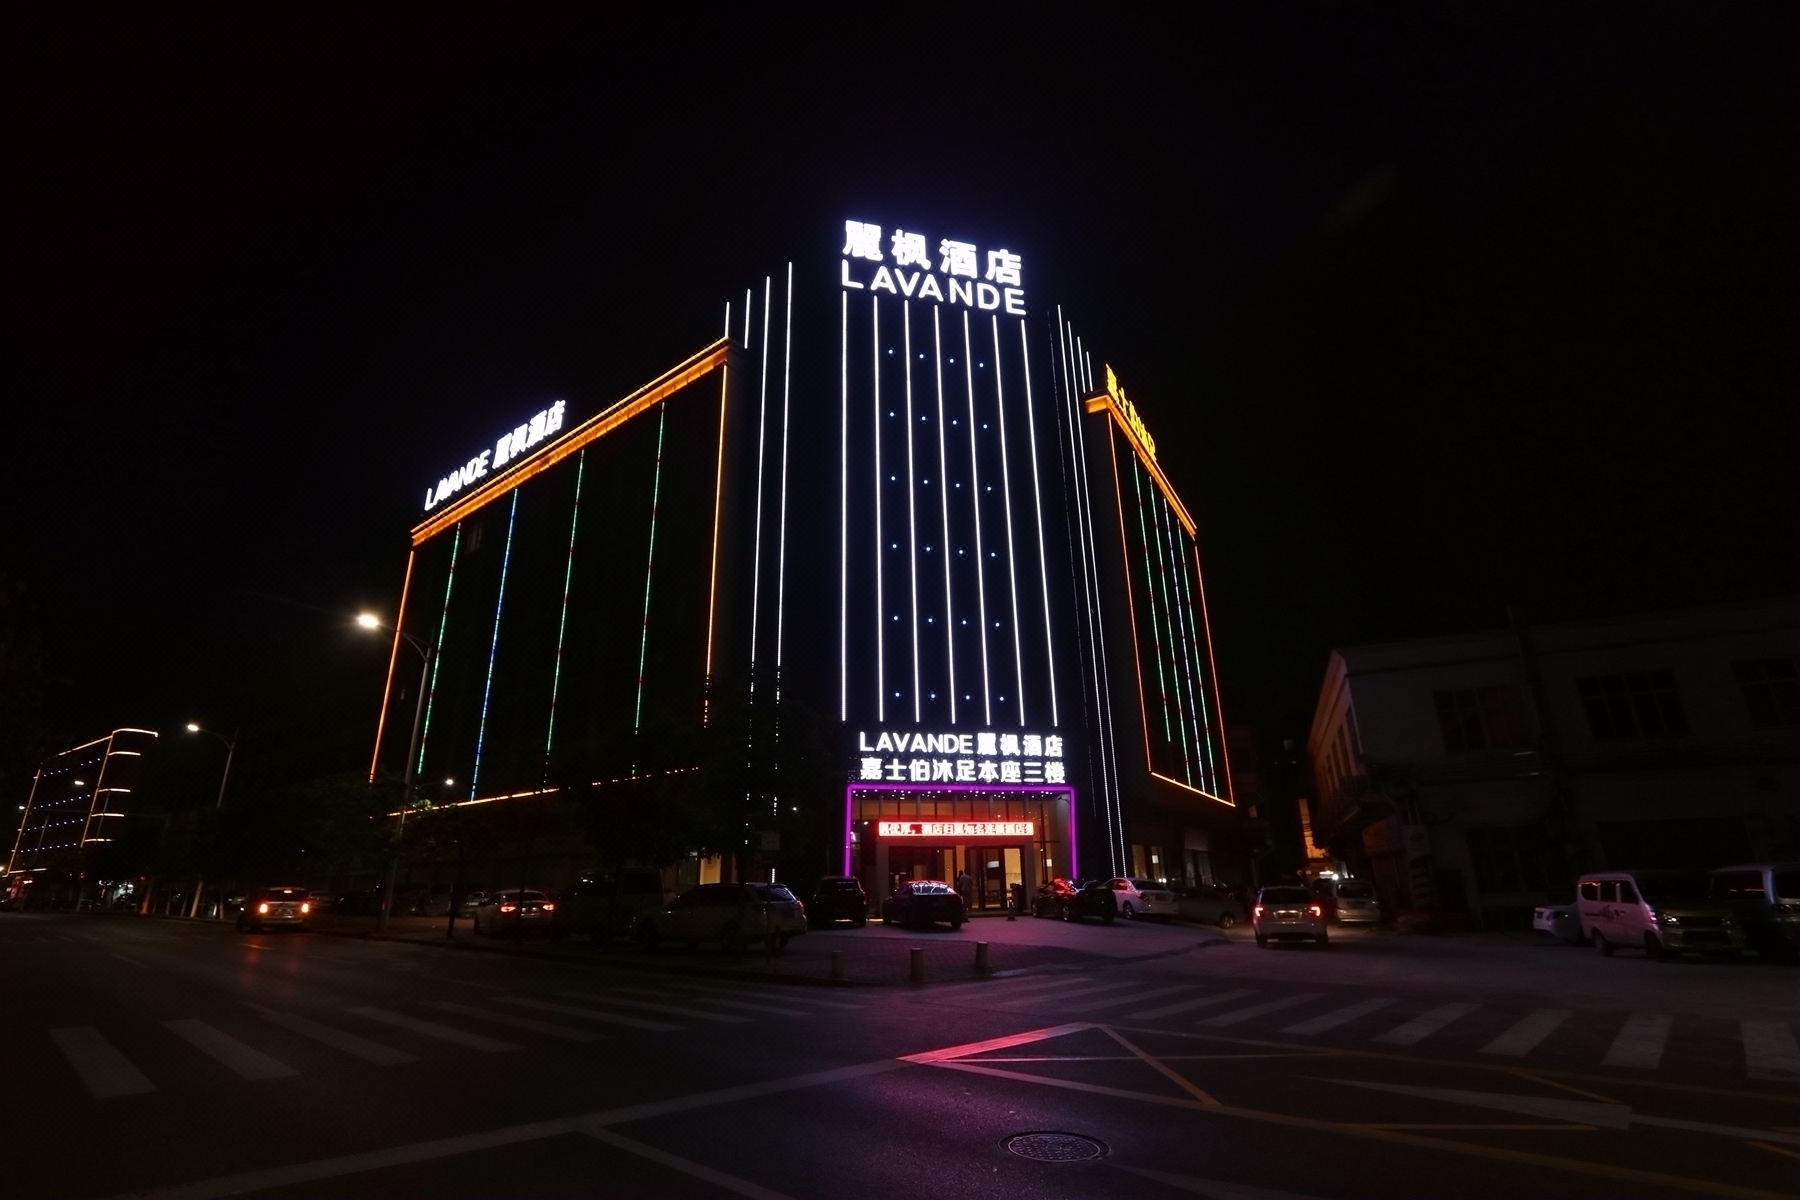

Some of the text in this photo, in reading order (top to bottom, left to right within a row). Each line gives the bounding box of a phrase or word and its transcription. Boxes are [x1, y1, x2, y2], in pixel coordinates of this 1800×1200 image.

[843, 220, 1021, 286] 麗枫酒店
[842, 259, 1026, 315] LAVANDE
[425, 449, 491, 511] LAVANDE
[860, 732, 973, 754] LAVANDE
[860, 757, 1065, 783] 嘉士伯沐足本座三楼
